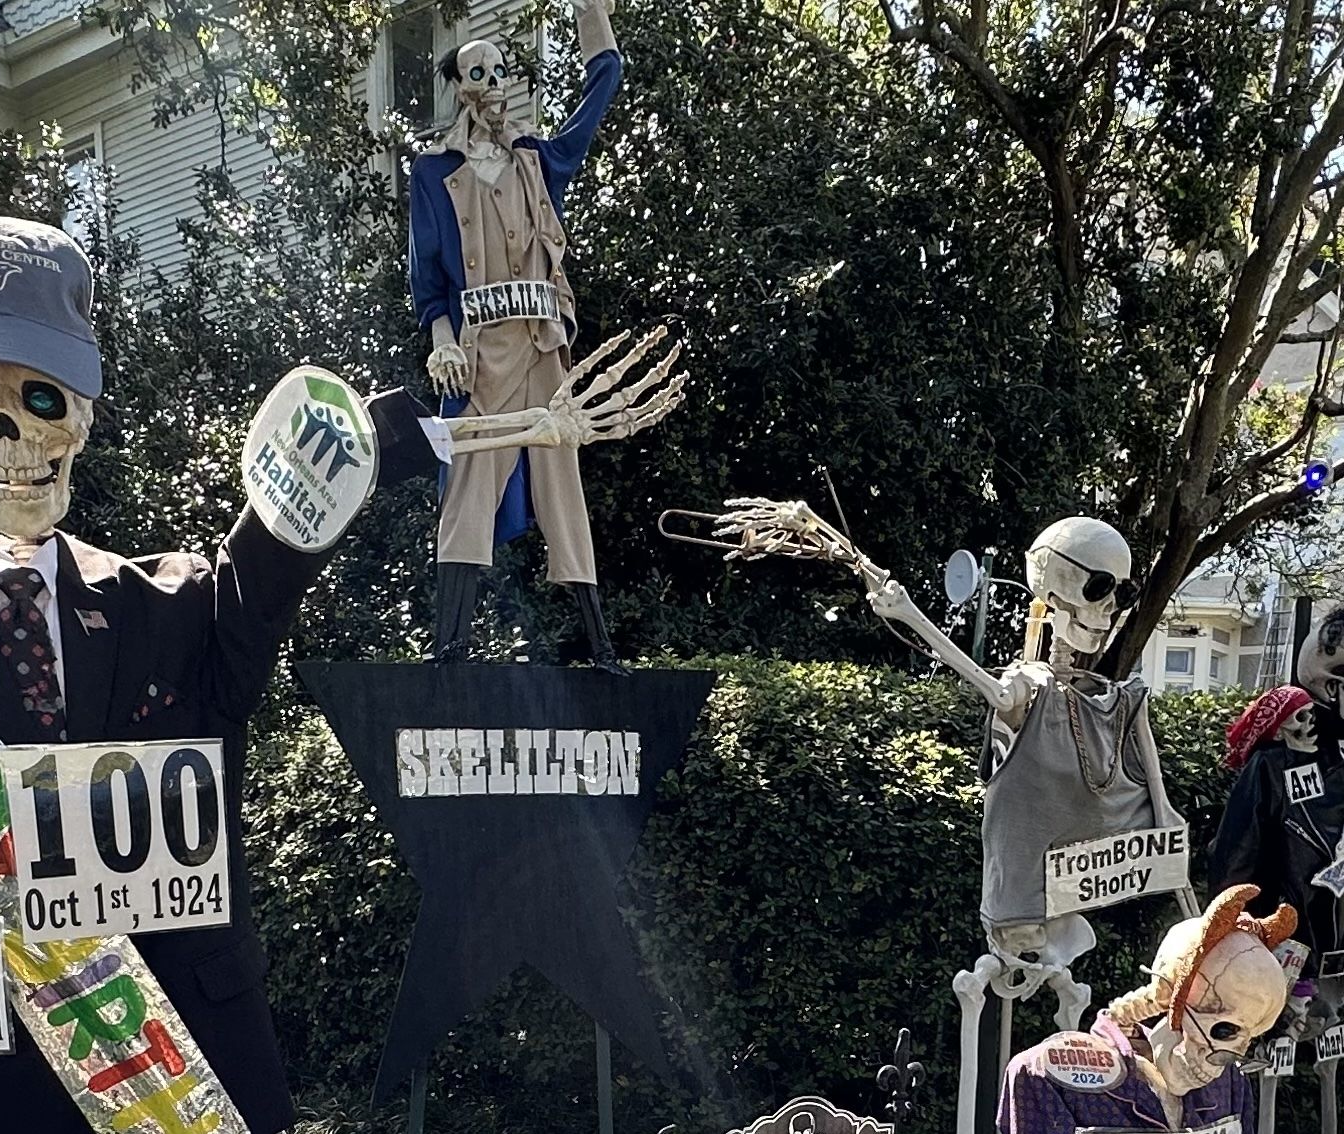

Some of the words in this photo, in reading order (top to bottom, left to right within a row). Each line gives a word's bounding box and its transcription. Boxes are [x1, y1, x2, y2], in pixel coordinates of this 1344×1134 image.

[1, 250, 62, 273] CENTER
[248, 464, 265, 488] for
[256, 442, 326, 532] Habitat
[289, 450, 319, 488] Orleans
[318, 485, 337, 509] Area
[398, 728, 640, 797] SKELILTON
[1291, 767, 1320, 801] Art
[21, 748, 219, 879] 100
[1049, 830, 1184, 878] TromBONE
[25, 888, 81, 931] Oct
[152, 873, 222, 919] 1924
[1078, 866, 1152, 901] Shorty
[1048, 1048, 1115, 1067] GEORGES
[1071, 1073, 1105, 1084] 2024
